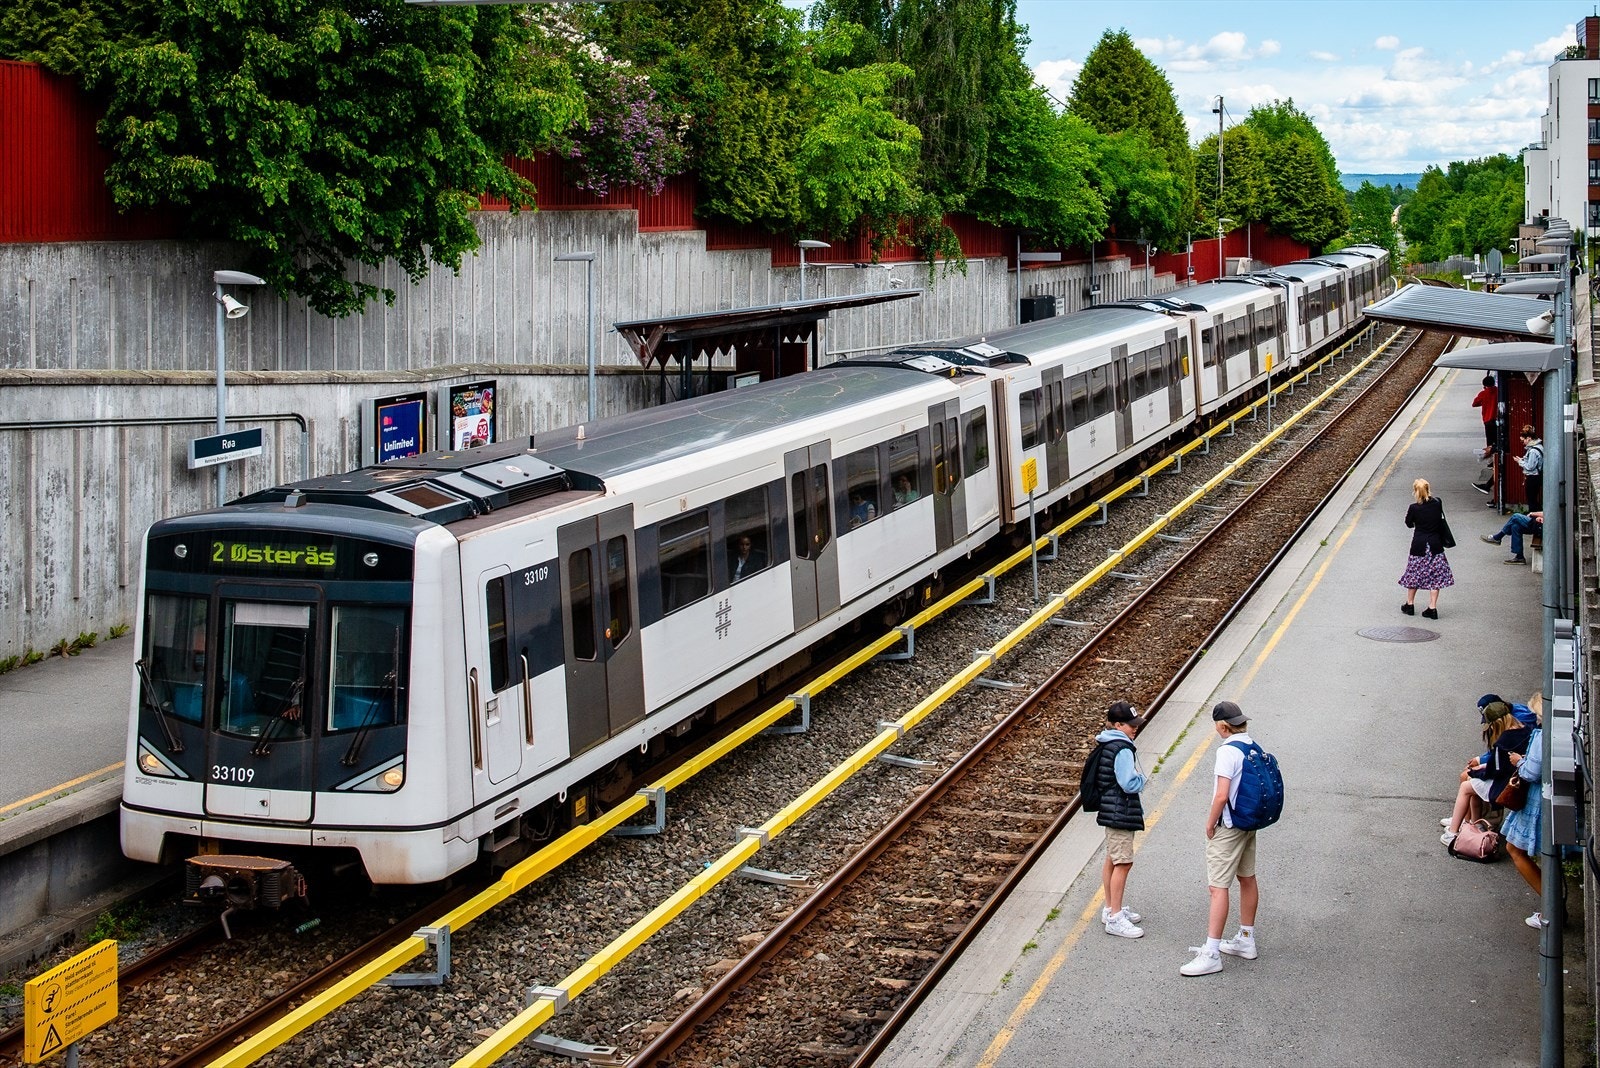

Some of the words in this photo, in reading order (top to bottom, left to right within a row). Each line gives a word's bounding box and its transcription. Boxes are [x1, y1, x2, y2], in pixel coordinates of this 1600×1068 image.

[222, 439, 236, 449] Røa
[384, 437, 414, 451] Unlimited
[213, 541, 224, 561] 2
[231, 543, 335, 565] Østerås
[524, 566, 549, 586] 33109
[212, 765, 255, 783] 33109
